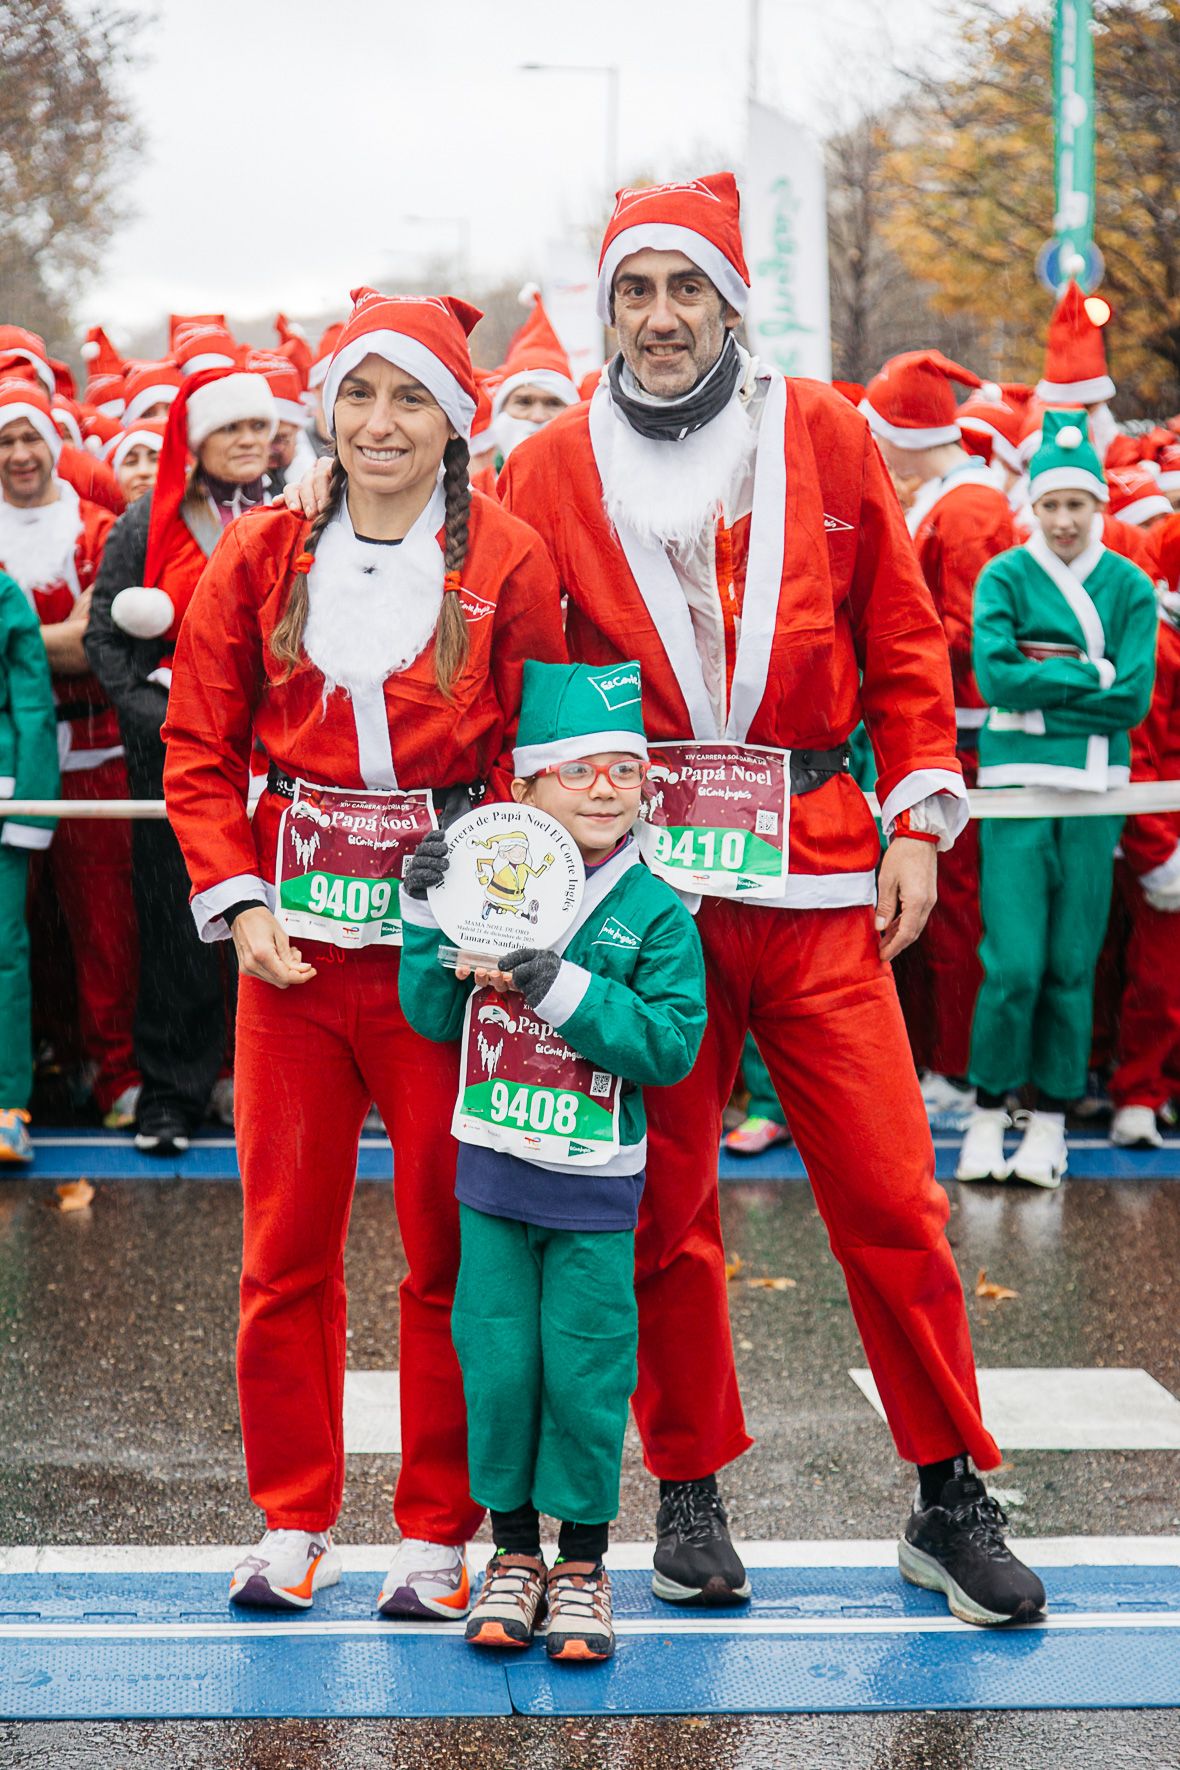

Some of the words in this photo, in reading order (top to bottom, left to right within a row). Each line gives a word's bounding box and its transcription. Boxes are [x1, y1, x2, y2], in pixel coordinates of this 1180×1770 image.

[680, 765, 726, 784] Papá
[731, 765, 772, 786] Noel
[698, 786, 706, 796] El
[706, 787, 724, 798] Corte
[331, 811, 378, 832] Papá
[476, 816, 489, 827] de
[492, 811, 521, 822] Papá
[526, 813, 551, 832] Noel
[348, 834, 356, 845] El
[355, 836, 374, 847] Corte
[448, 824, 474, 854] arrera
[550, 829, 563, 843] El
[560, 843, 576, 875] Corte
[655, 830, 746, 870] 9410
[308, 874, 392, 921] 9409
[562, 879, 578, 911] Inglés
[460, 932, 491, 945] Tamara
[535, 1043, 544, 1054] El
[543, 1045, 562, 1057] Corte
[490, 1081, 579, 1135] 9408
